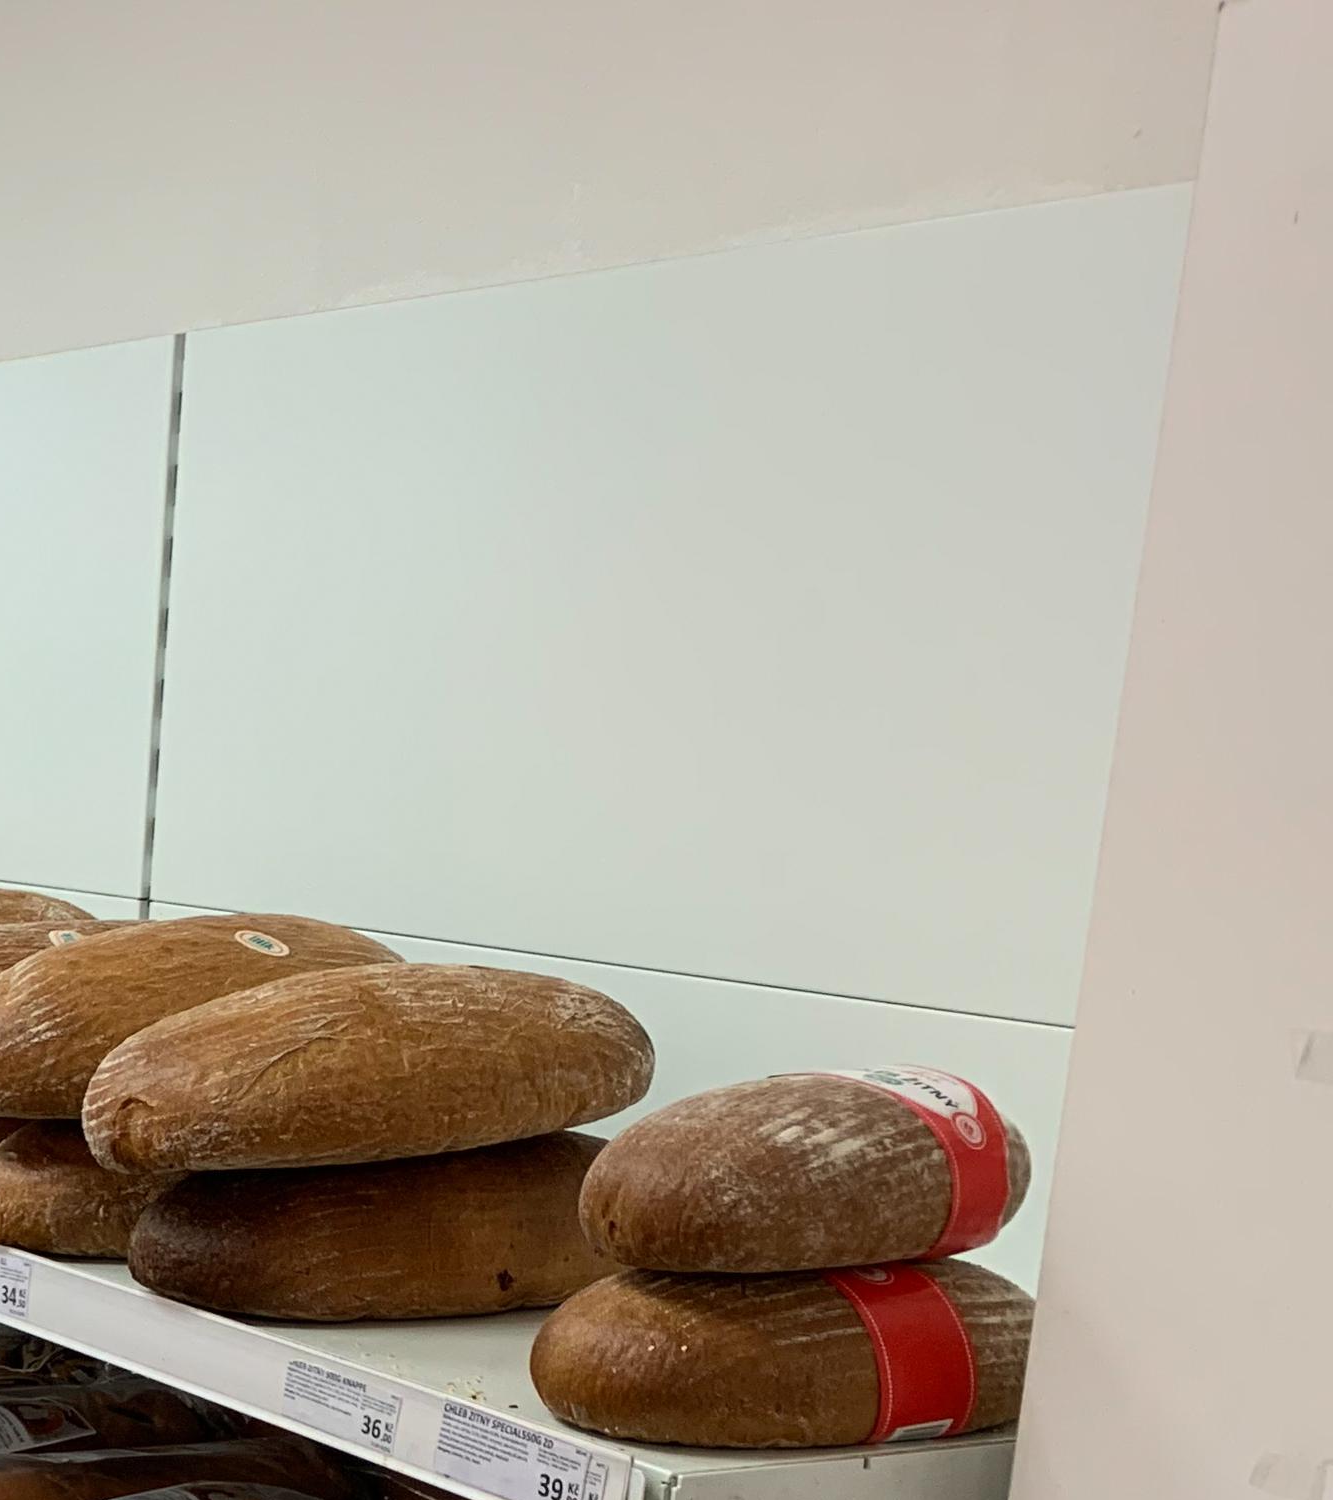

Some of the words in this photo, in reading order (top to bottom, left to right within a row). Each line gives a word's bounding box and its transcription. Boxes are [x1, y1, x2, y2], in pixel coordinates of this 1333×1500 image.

[1, 1285, 17, 1307] 34
[444, 1403, 468, 1419] CHLEB
[361, 1415, 382, 1439] 36
